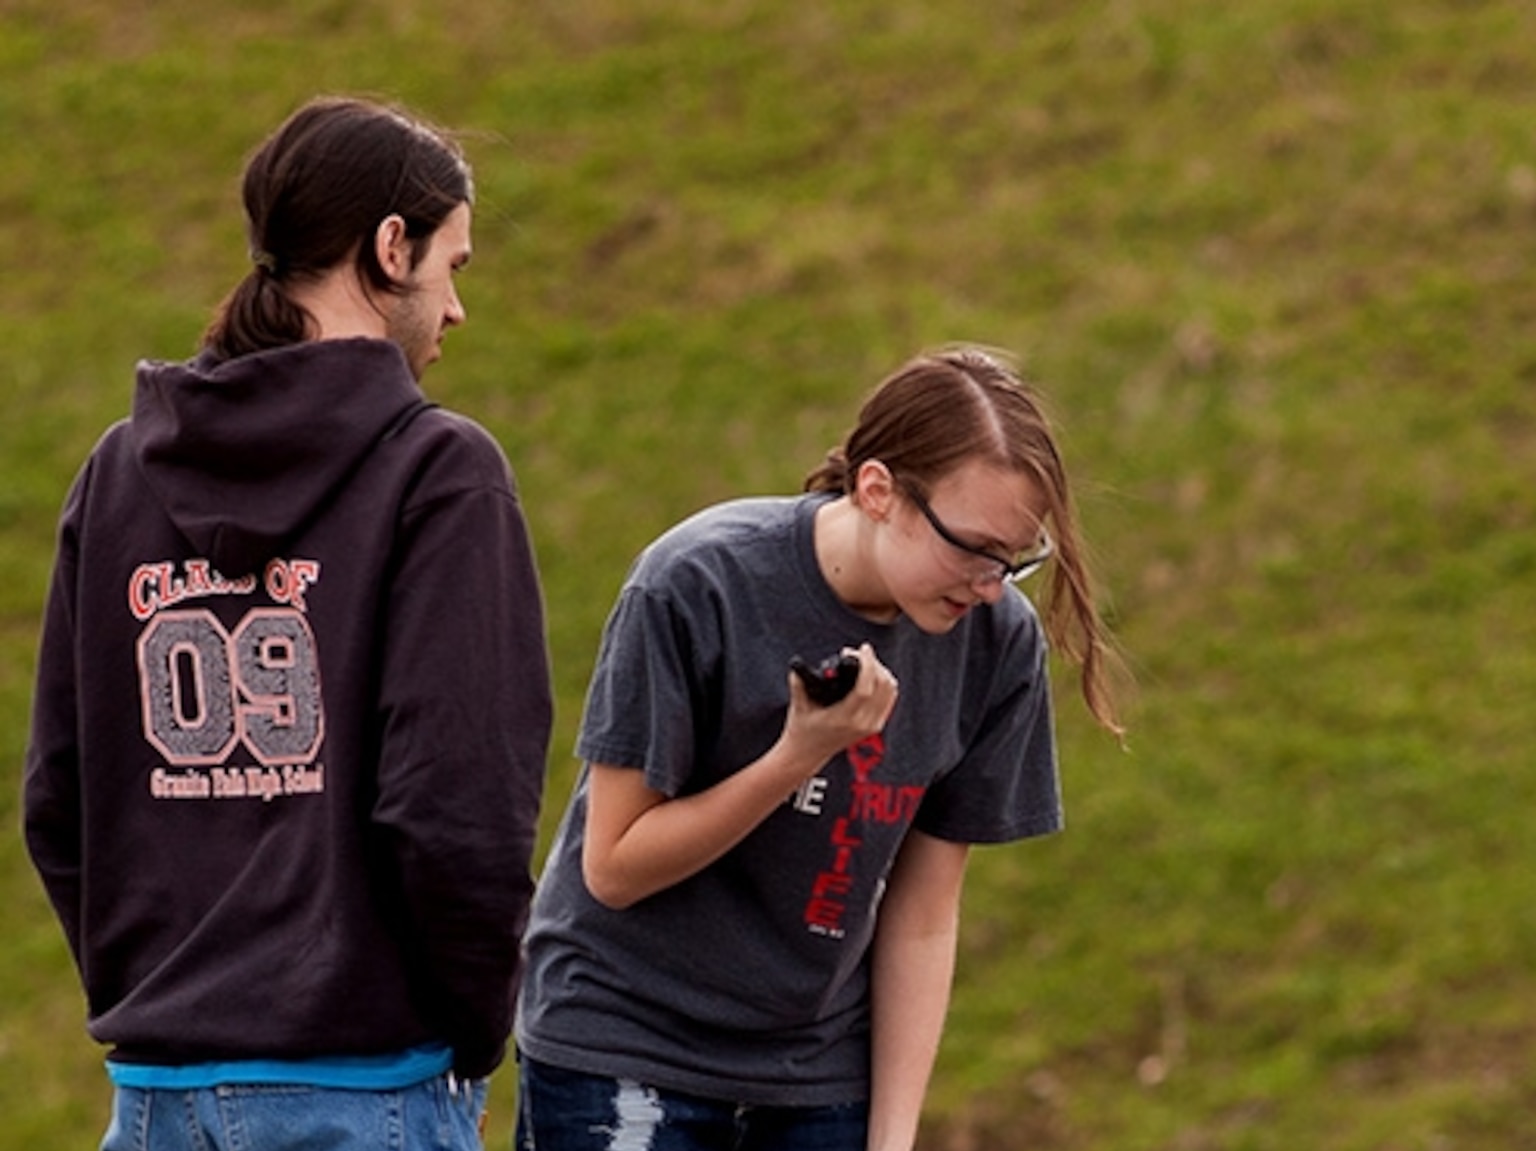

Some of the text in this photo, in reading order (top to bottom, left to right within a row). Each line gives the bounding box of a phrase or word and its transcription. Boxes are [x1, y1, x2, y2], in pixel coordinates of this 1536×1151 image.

[264, 557, 320, 612] OF
[136, 606, 326, 765] 09
[848, 779, 928, 826] TRUT
